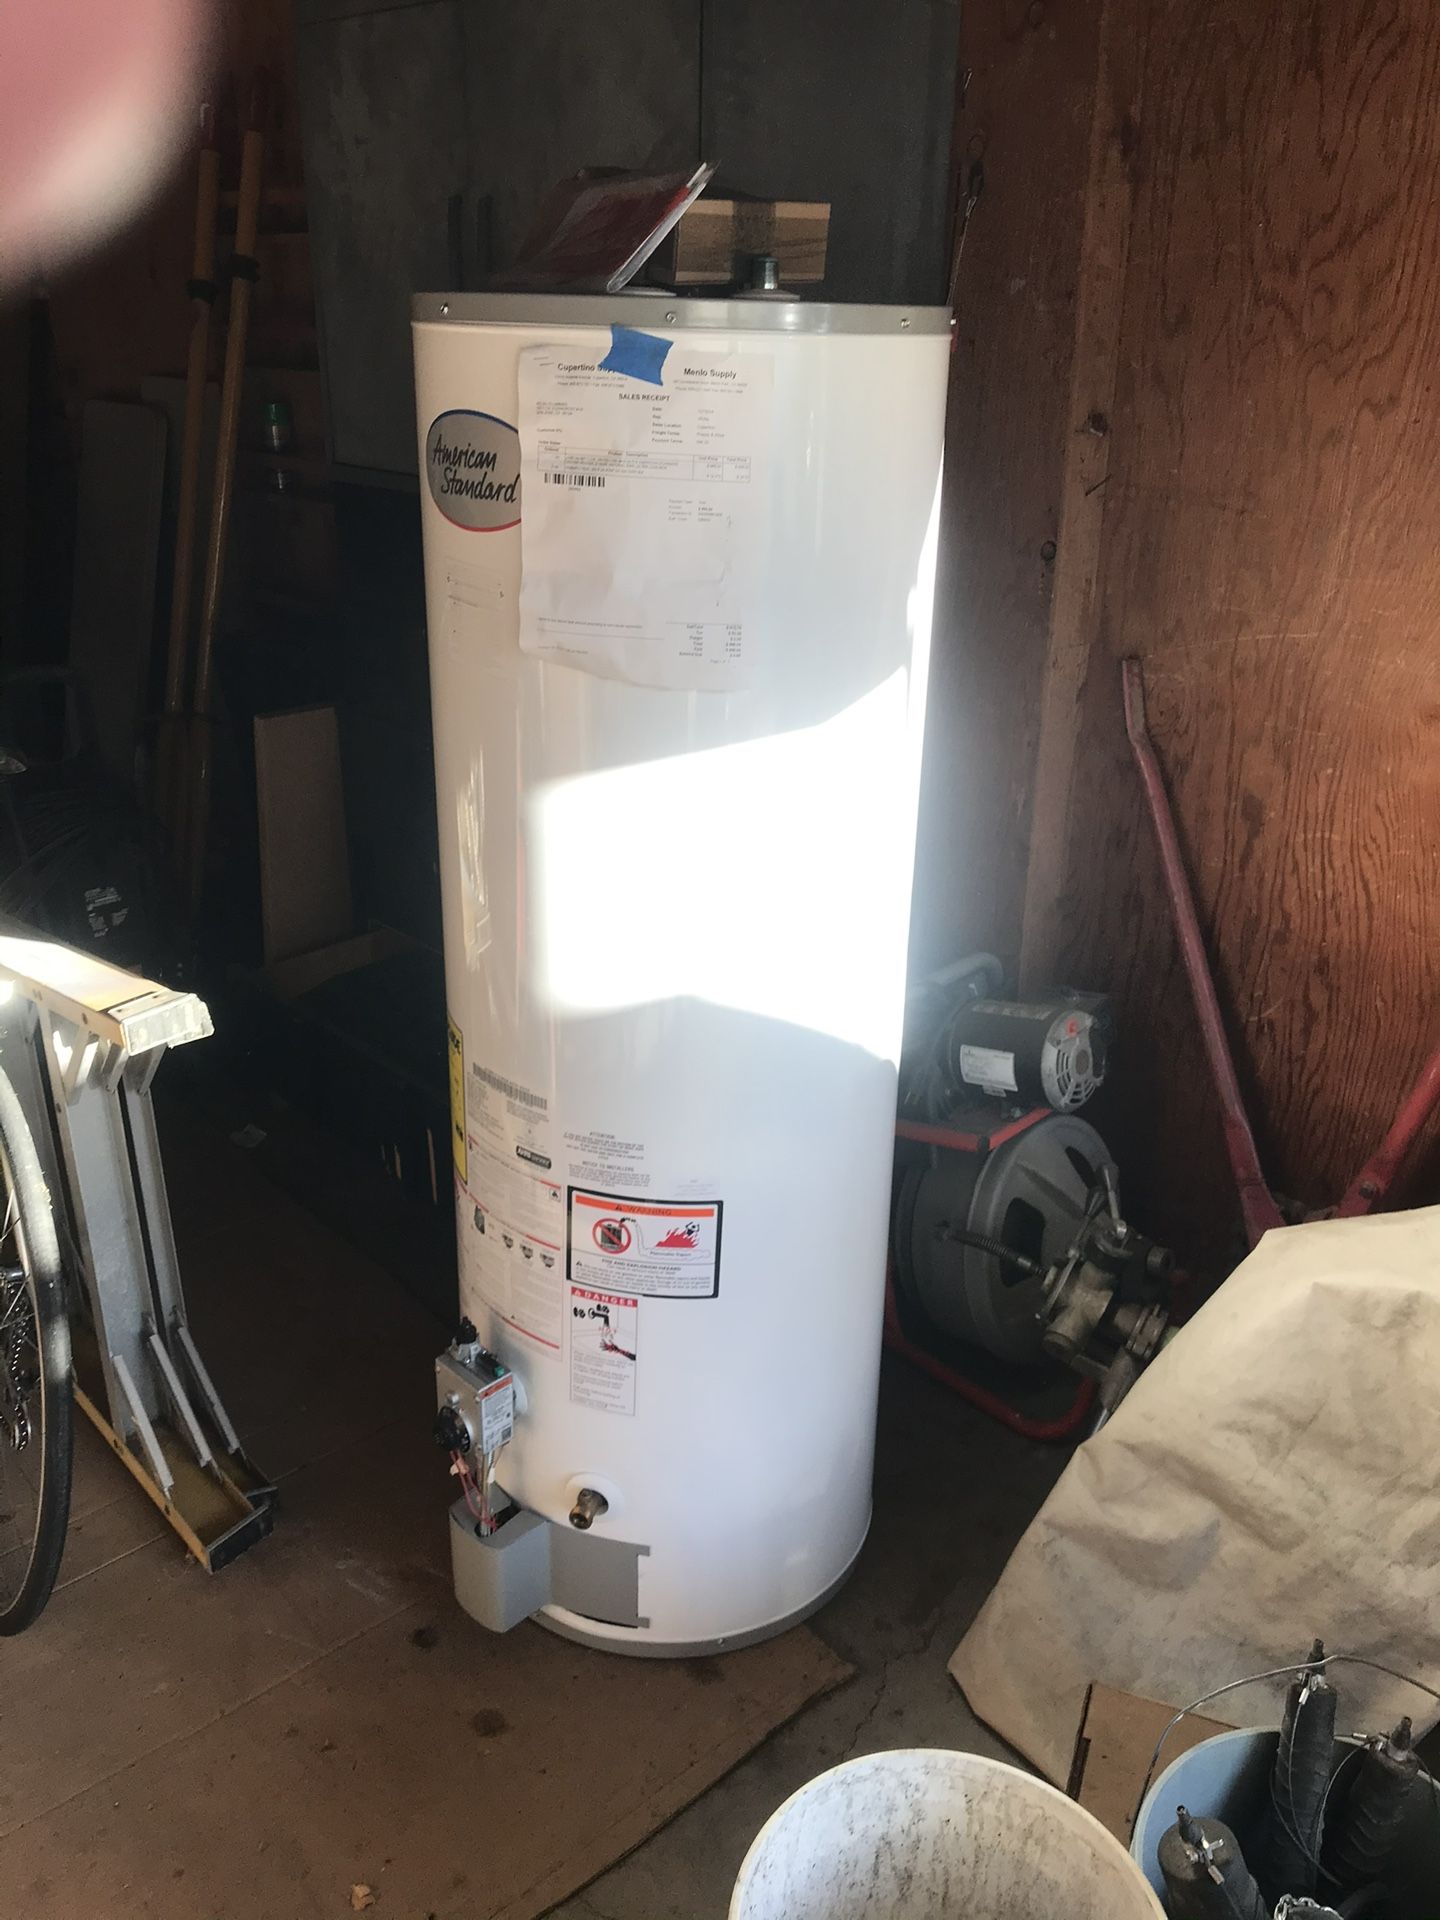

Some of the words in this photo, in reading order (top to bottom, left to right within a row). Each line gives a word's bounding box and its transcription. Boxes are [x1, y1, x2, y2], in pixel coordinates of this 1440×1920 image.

[557, 362, 595, 374] Cupertino
[683, 367, 708, 377] Menlo
[710, 368, 737, 381] Supply
[618, 393, 640, 401] SALES
[642, 394, 670, 402] RECEIPT
[432, 434, 497, 472] American
[441, 466, 521, 504] Standard
[626, 1206, 673, 1217] WARNING
[584, 1291, 633, 1307] DANGER
